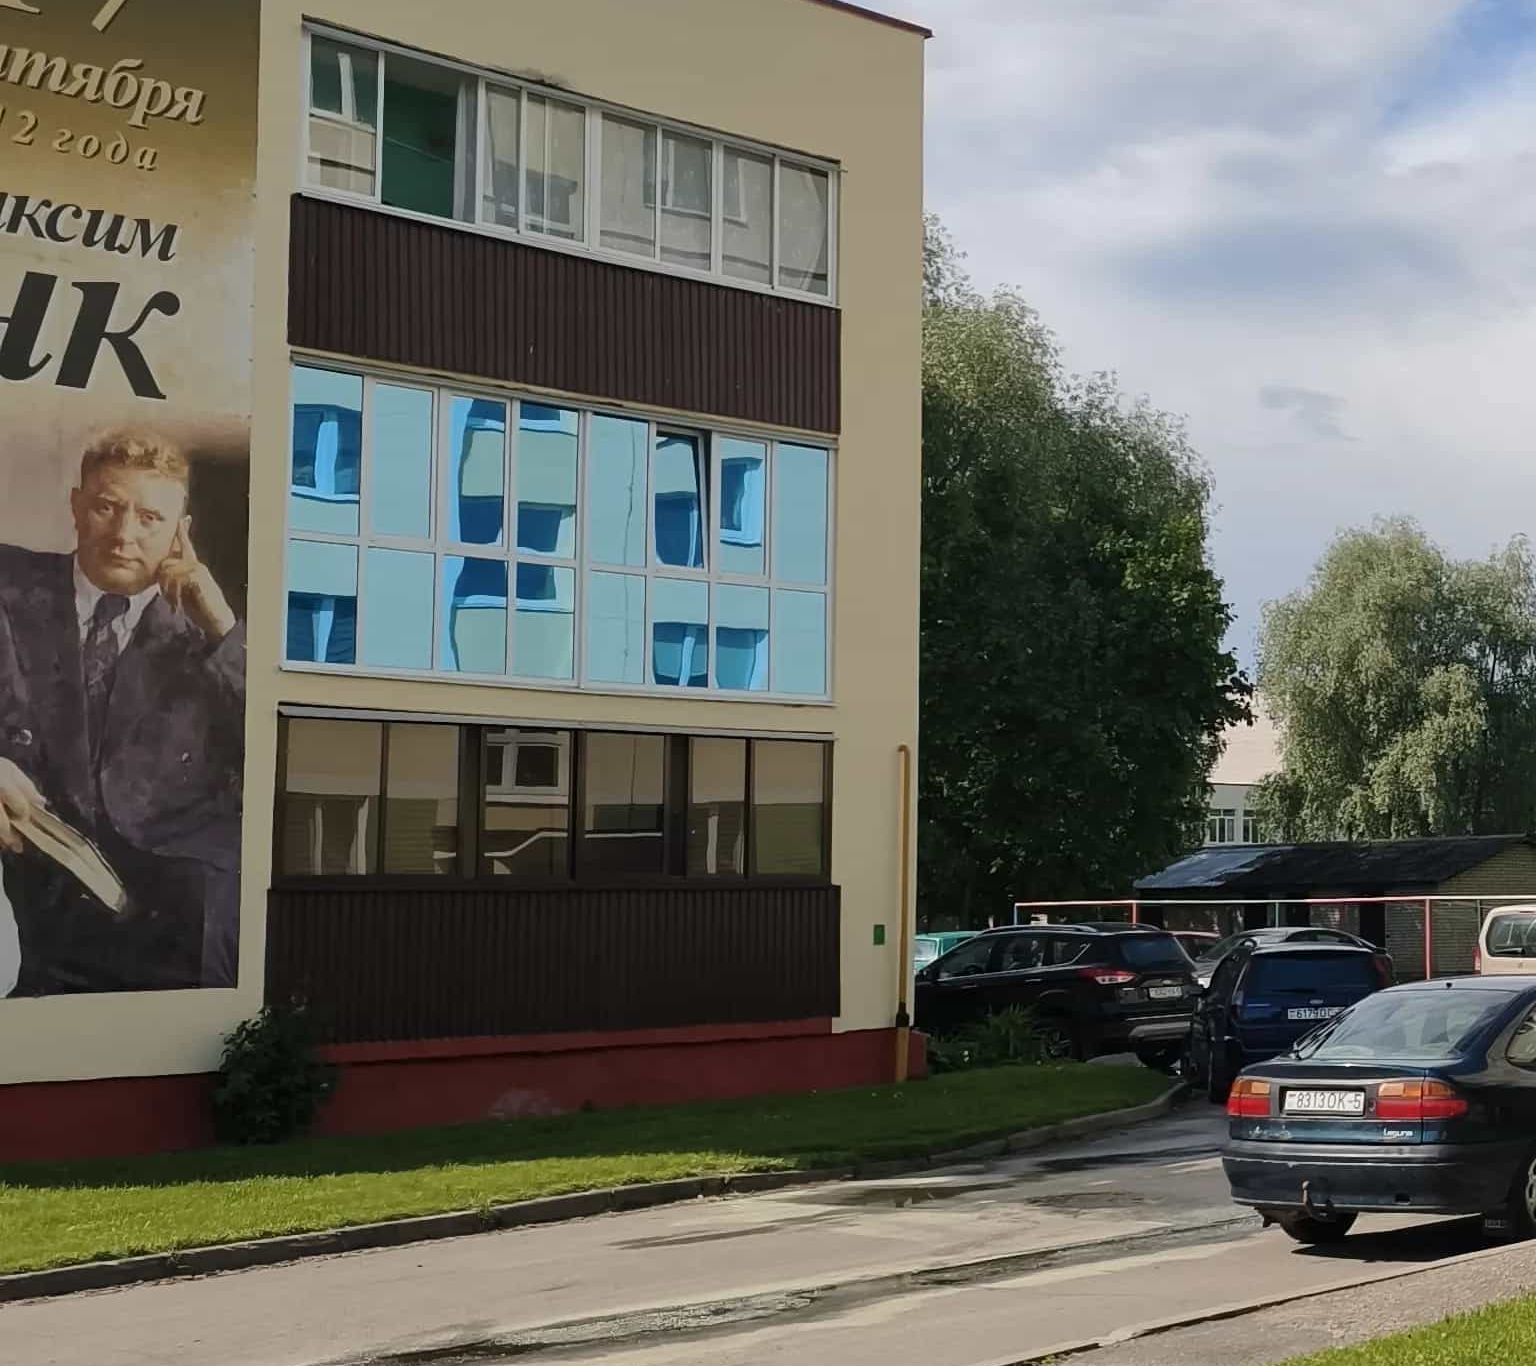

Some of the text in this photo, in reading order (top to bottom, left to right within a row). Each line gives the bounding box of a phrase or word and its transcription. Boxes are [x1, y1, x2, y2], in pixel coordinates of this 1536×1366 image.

[0, 44, 205, 129] тября
[52, 128, 159, 171] года
[0, 191, 179, 262] ксим
